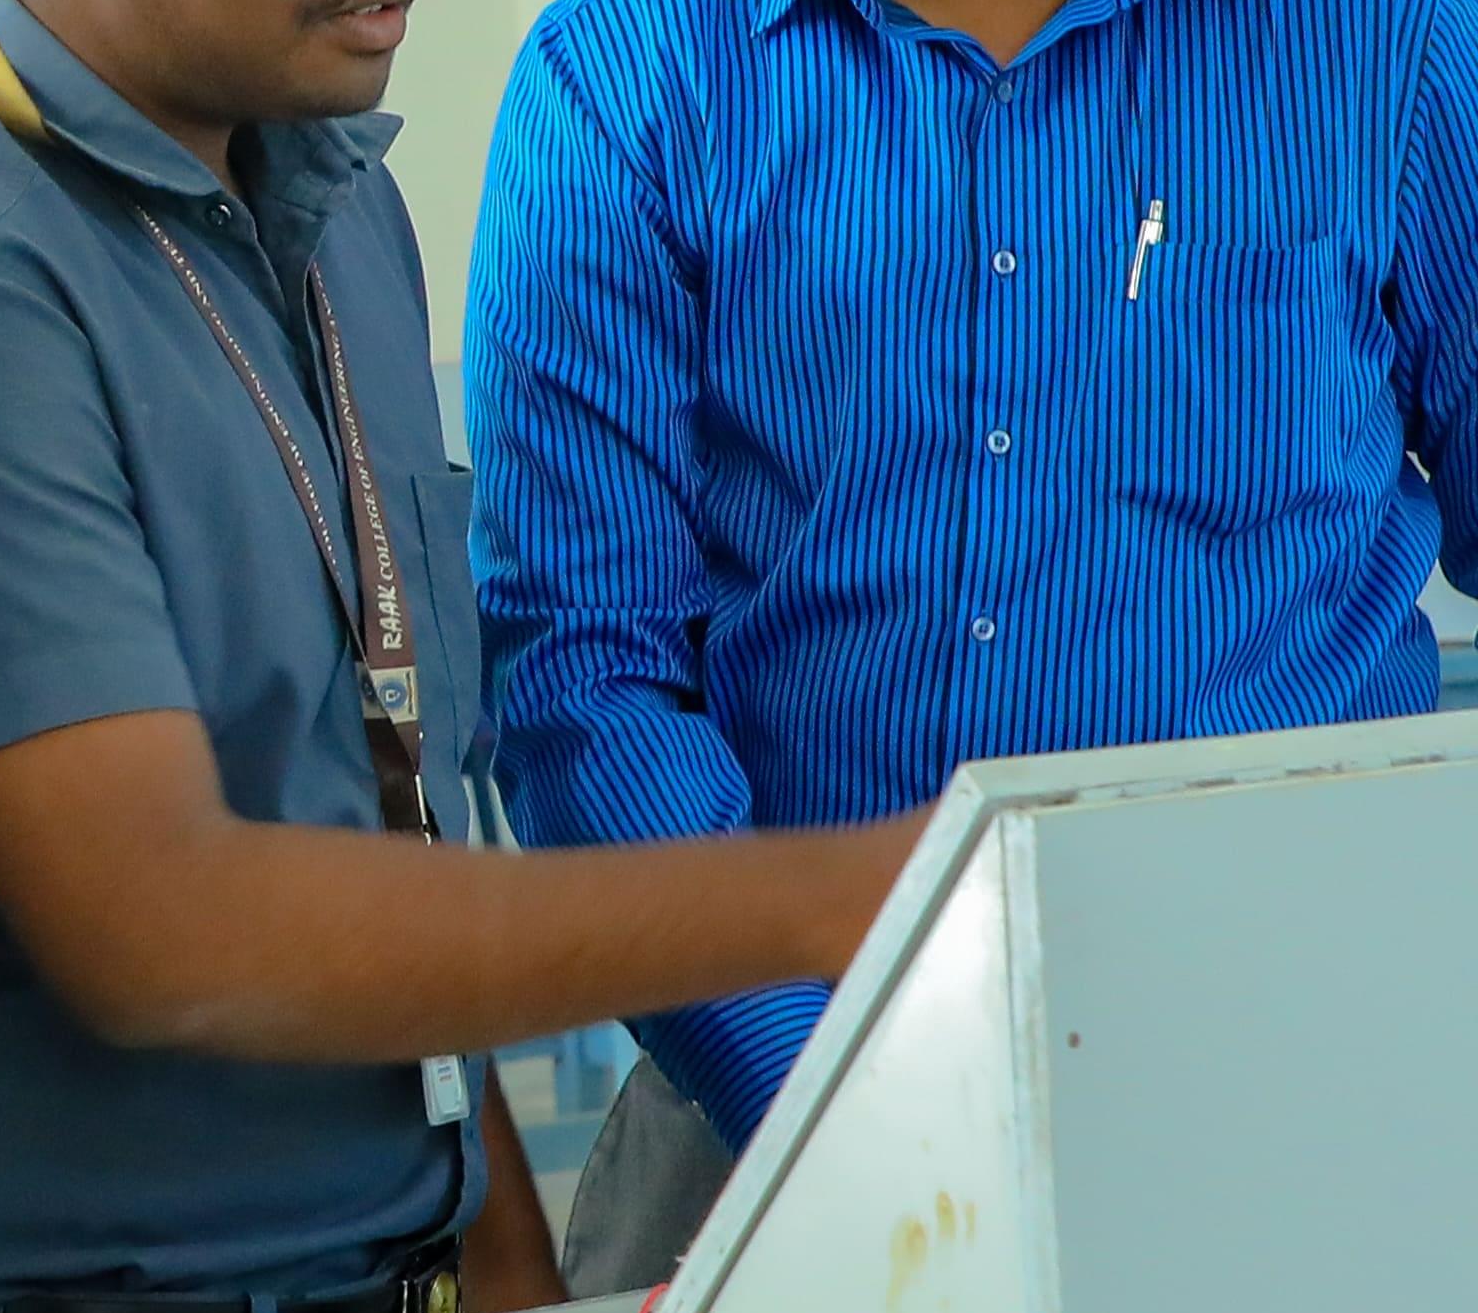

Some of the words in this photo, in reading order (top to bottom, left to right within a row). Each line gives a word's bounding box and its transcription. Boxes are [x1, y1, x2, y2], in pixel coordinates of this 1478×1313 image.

[331, 334, 365, 460] ENGINEERING
[356, 467, 373, 490] OF
[363, 491, 394, 581] COLLEGE
[376, 585, 404, 649] RAAK
